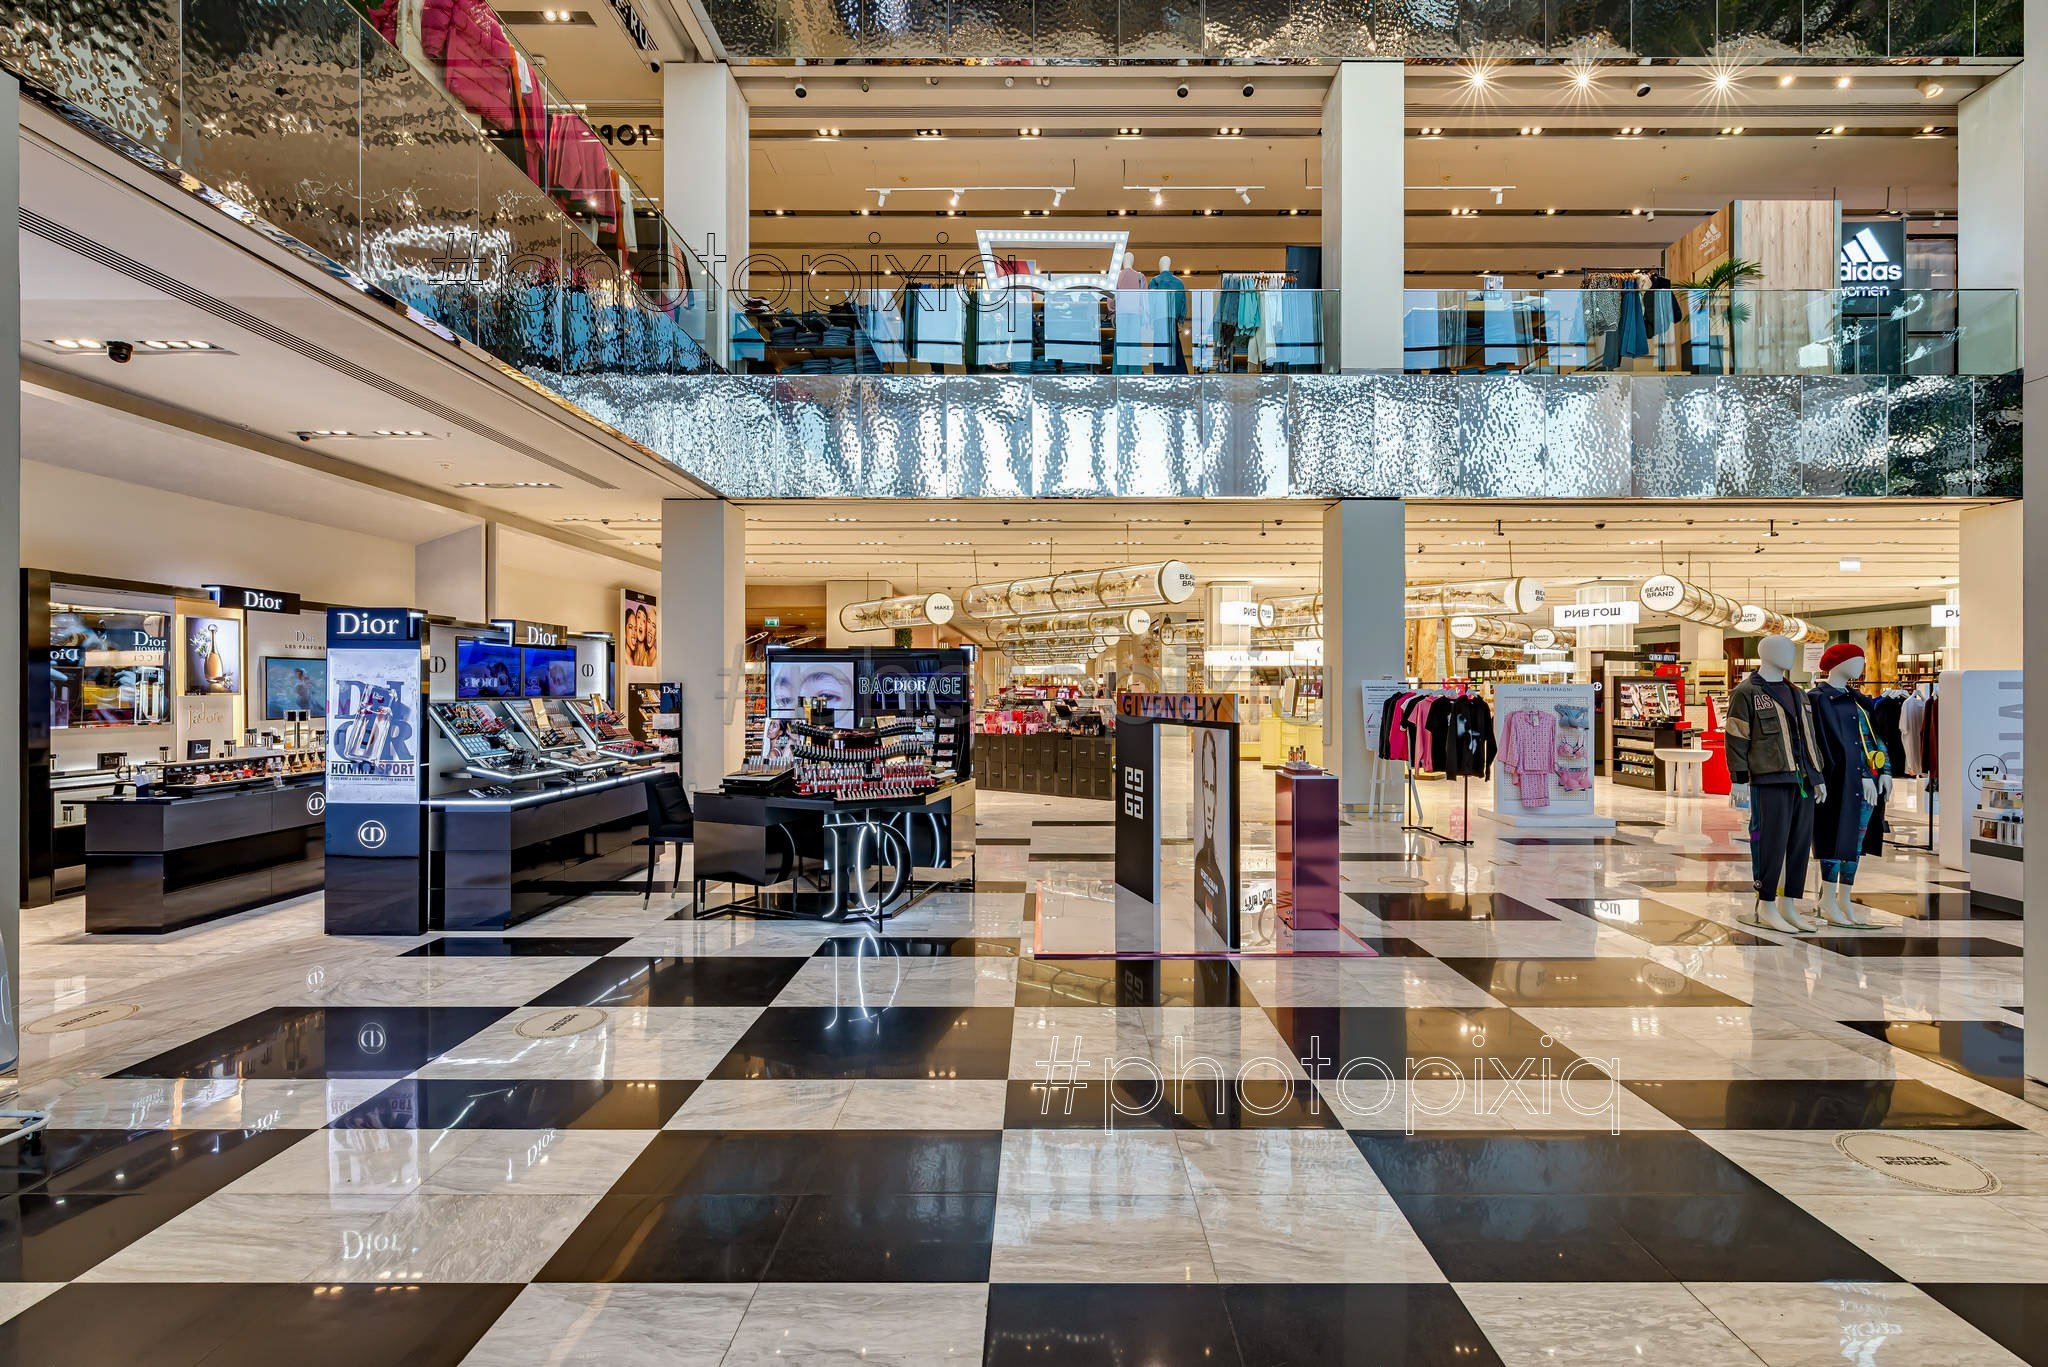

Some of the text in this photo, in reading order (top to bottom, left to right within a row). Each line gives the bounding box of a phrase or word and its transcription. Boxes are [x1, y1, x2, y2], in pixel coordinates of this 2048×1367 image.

[1841, 262, 1903, 281] didas
[244, 591, 282, 610] Dior
[336, 612, 400, 634] Dior
[133, 631, 166, 647] Dior
[528, 626, 558, 646] Dior
[1122, 695, 1222, 721] GIVENCHY
[378, 764, 414, 775] SPORT
